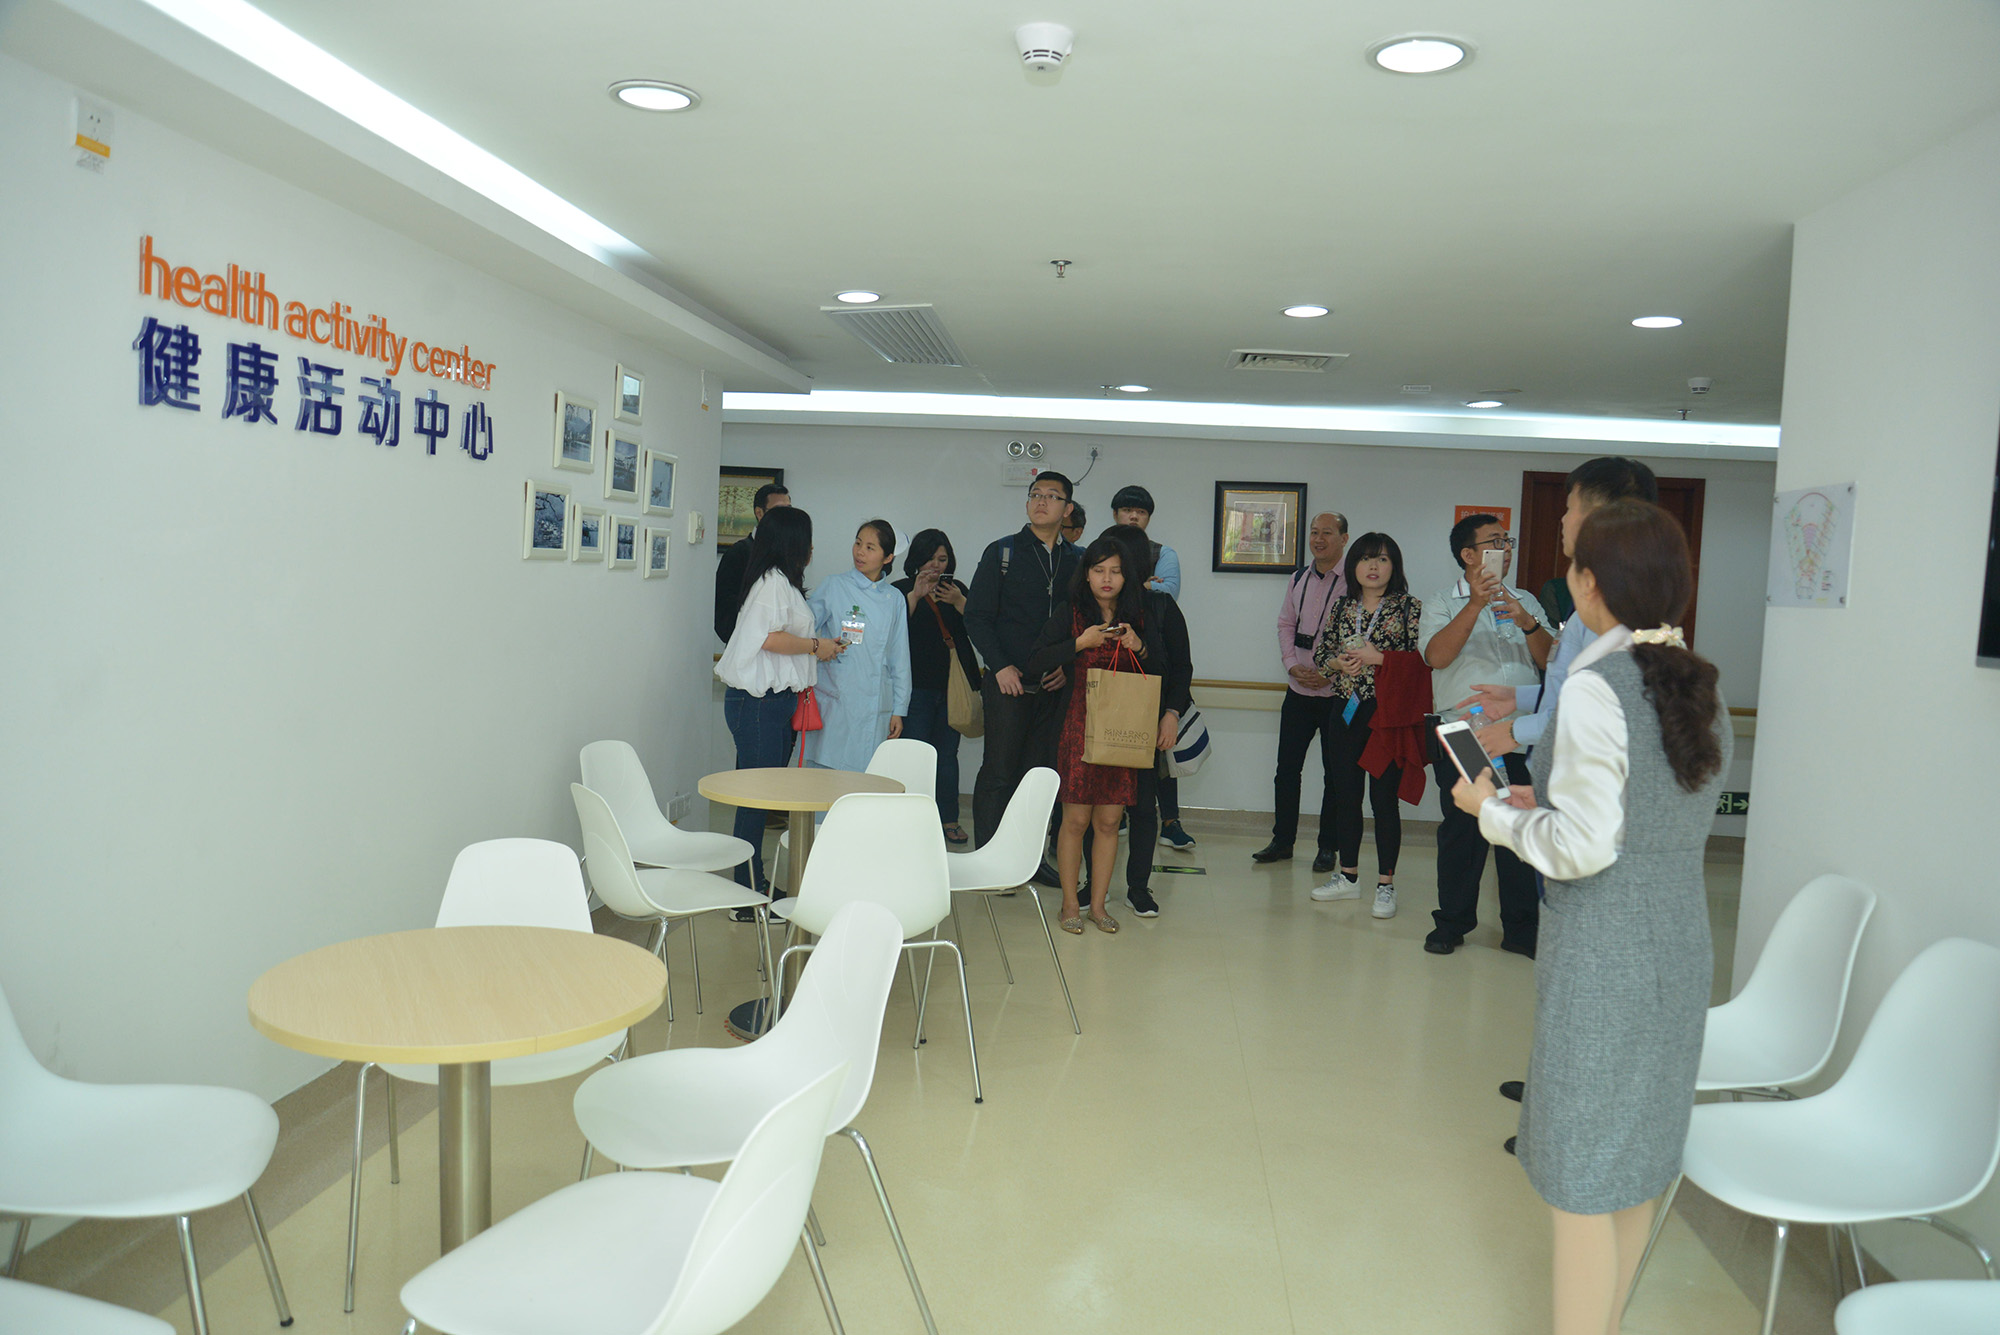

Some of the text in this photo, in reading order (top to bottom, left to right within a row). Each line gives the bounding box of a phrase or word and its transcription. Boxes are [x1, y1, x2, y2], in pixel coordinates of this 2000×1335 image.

[139, 234, 496, 391] health activity center
[132, 316, 493, 461] 健康活动中心
